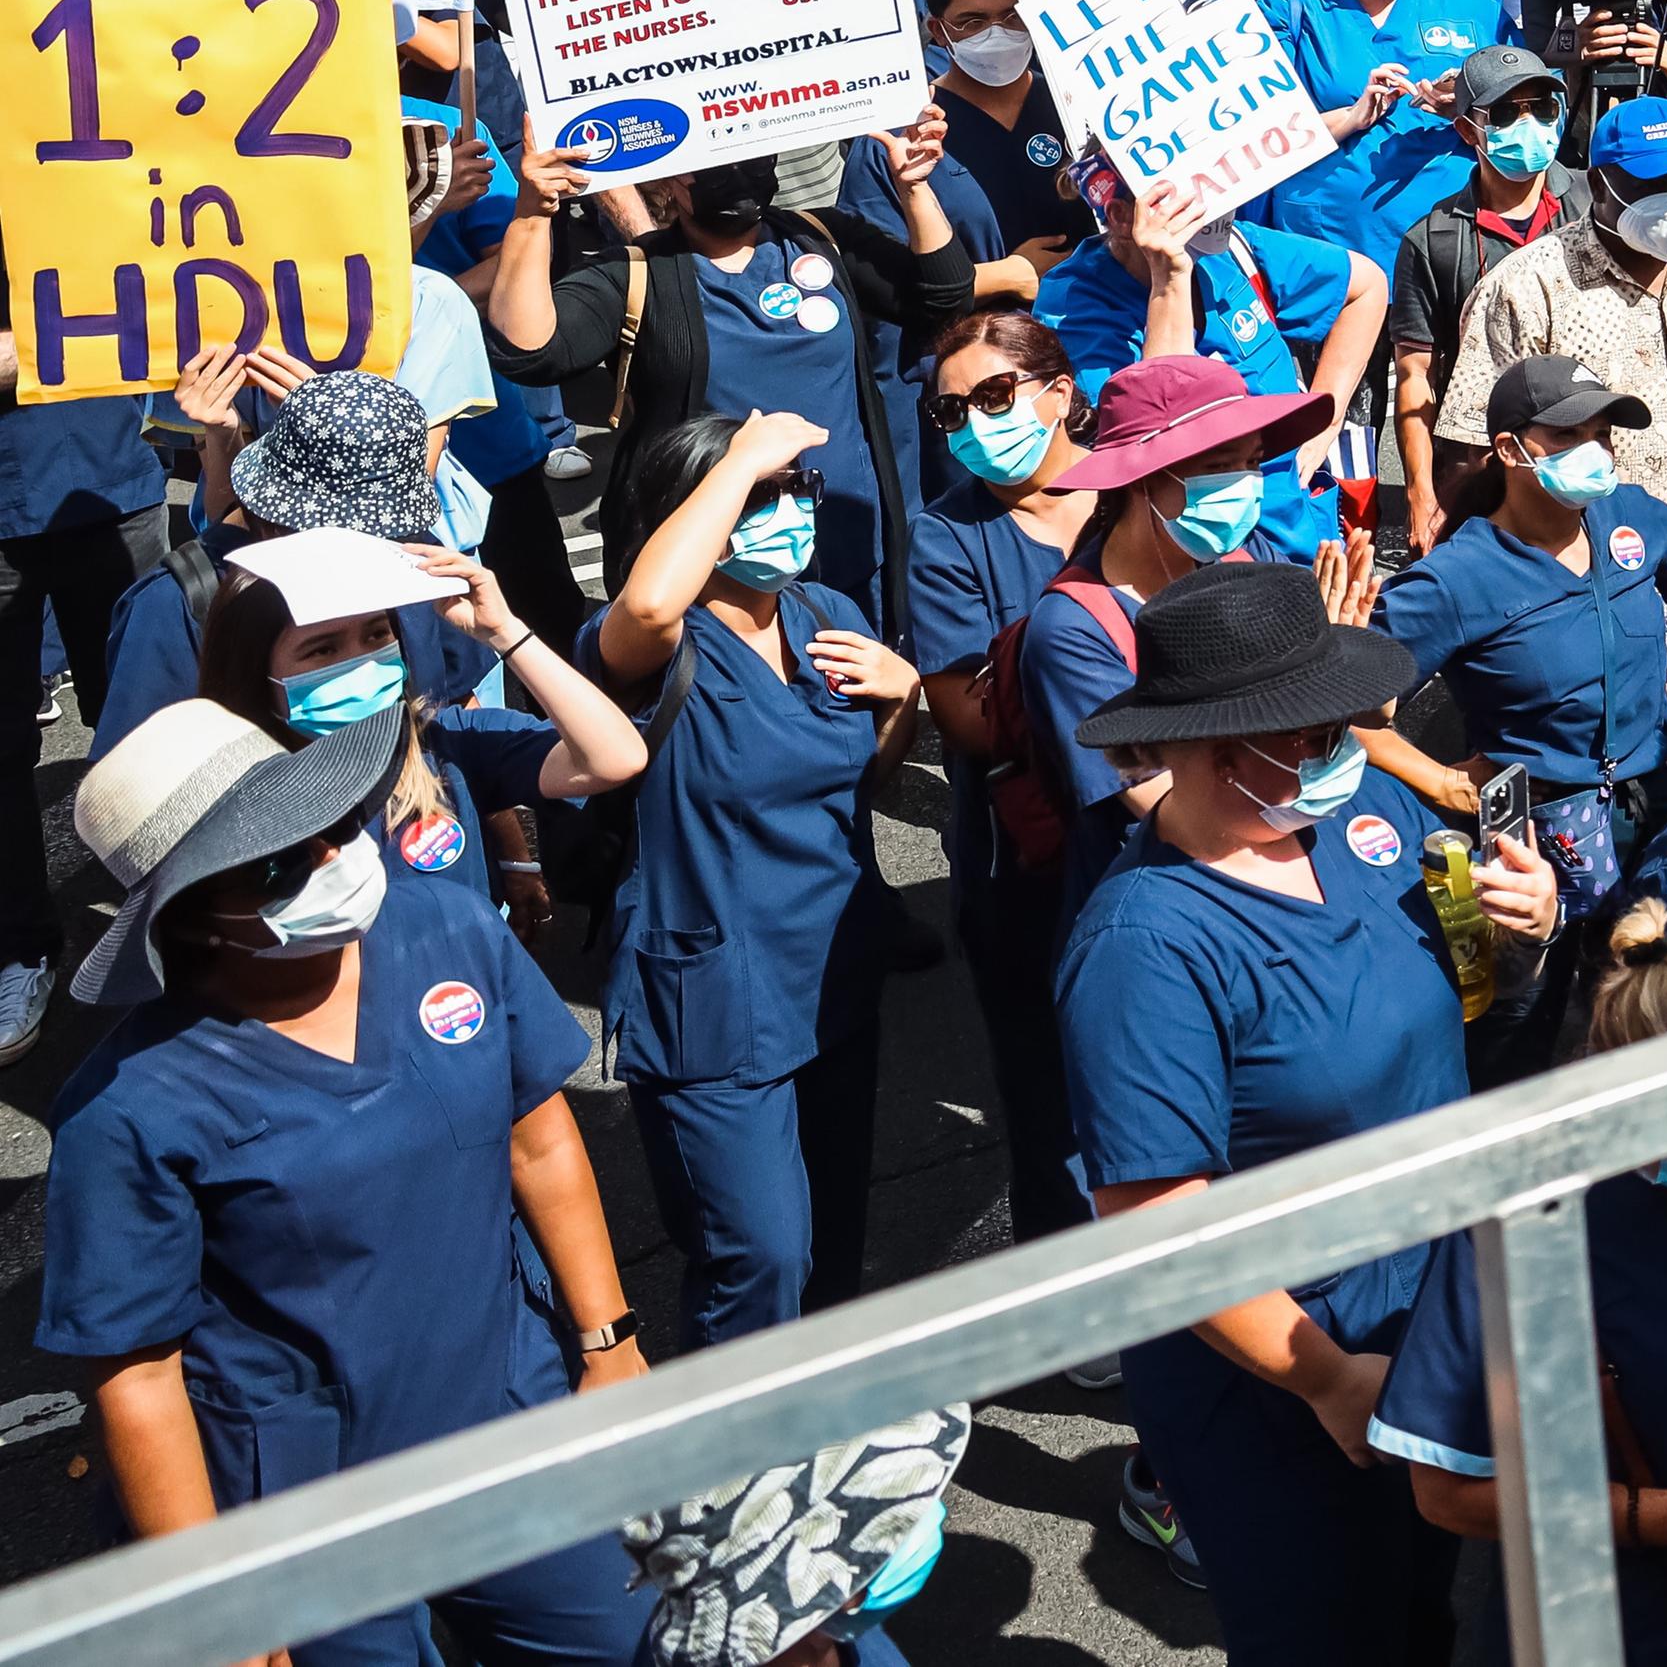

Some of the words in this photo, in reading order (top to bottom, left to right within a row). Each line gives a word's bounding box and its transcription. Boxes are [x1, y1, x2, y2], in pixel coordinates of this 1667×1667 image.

[555, 35, 608, 61] THE
[614, 11, 715, 48] NURSES.
[569, 51, 717, 97] BLACTOWN
[717, 26, 849, 69] HOSPITAL
[1075, 6, 1172, 89] THE
[1103, 13, 1271, 141] GAMES
[1126, 59, 1298, 178] BEGIN
[149, 168, 244, 247] in
[34, 254, 373, 385] HDU
